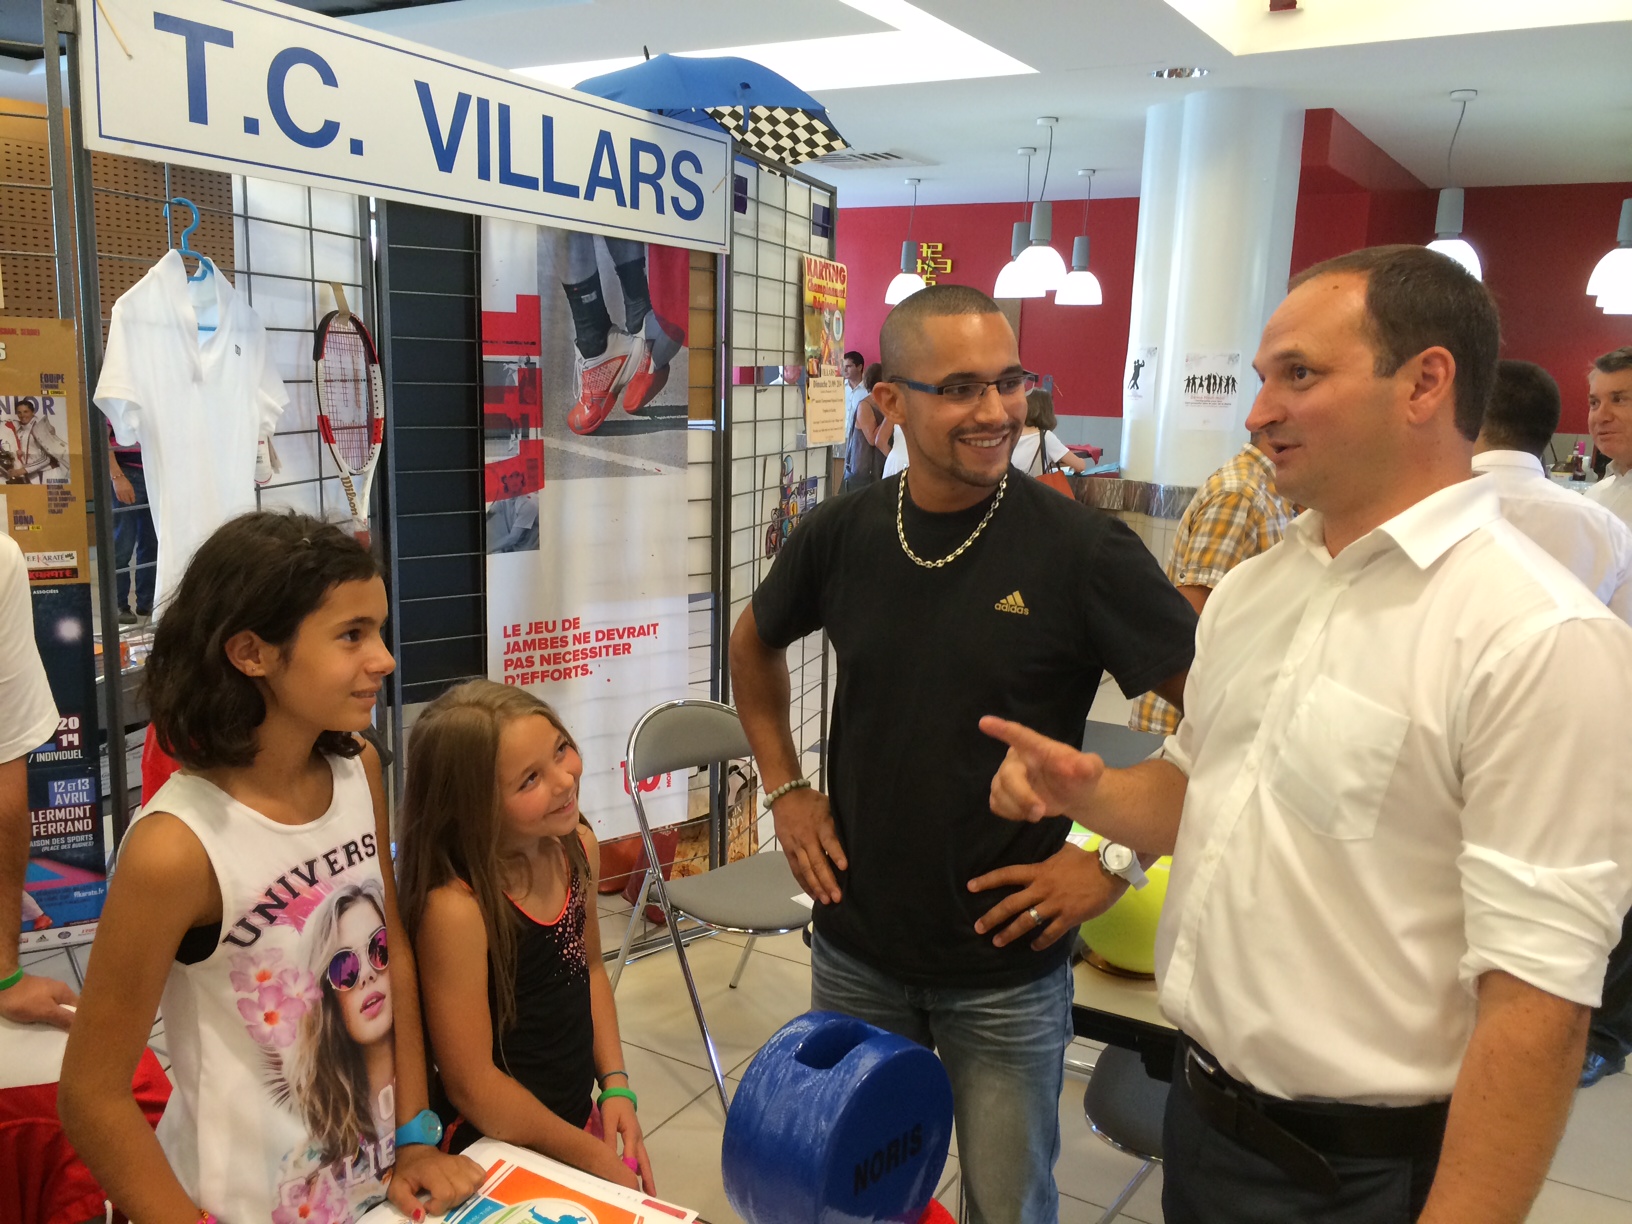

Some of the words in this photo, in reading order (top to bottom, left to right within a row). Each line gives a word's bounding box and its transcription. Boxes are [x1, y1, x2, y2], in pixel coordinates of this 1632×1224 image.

[153, 11, 364, 156] T.C.
[414, 79, 705, 221] VILLARS
[806, 256, 847, 286] KARTING
[340, 475, 358, 516] Wilson
[994, 602, 1030, 616] adidas
[503, 624, 521, 638] LE
[525, 620, 557, 635] JEU
[562, 617, 580, 632] DE
[503, 635, 569, 655] JAMBES
[573, 631, 591, 646] NE
[595, 622, 659, 642] DEVRAIT
[504, 655, 535, 672] PAS
[540, 642, 632, 667] NECESSITER
[504, 663, 593, 686] D'EFFORTS.
[57, 716, 80, 730] 20
[59, 732, 80, 747] 14
[36, 749, 83, 762] INDIVIDUEL
[54, 780, 65, 793] 12
[67, 782, 76, 791] ET
[77, 778, 90, 790] 13
[55, 791, 90, 805] AVRIL
[30, 805, 92, 823] LERMONT
[32, 819, 92, 836] FERRAND
[52, 837, 65, 845] DES
[67, 834, 94, 843] SPORTS
[222, 833, 377, 948] UNIVERS
